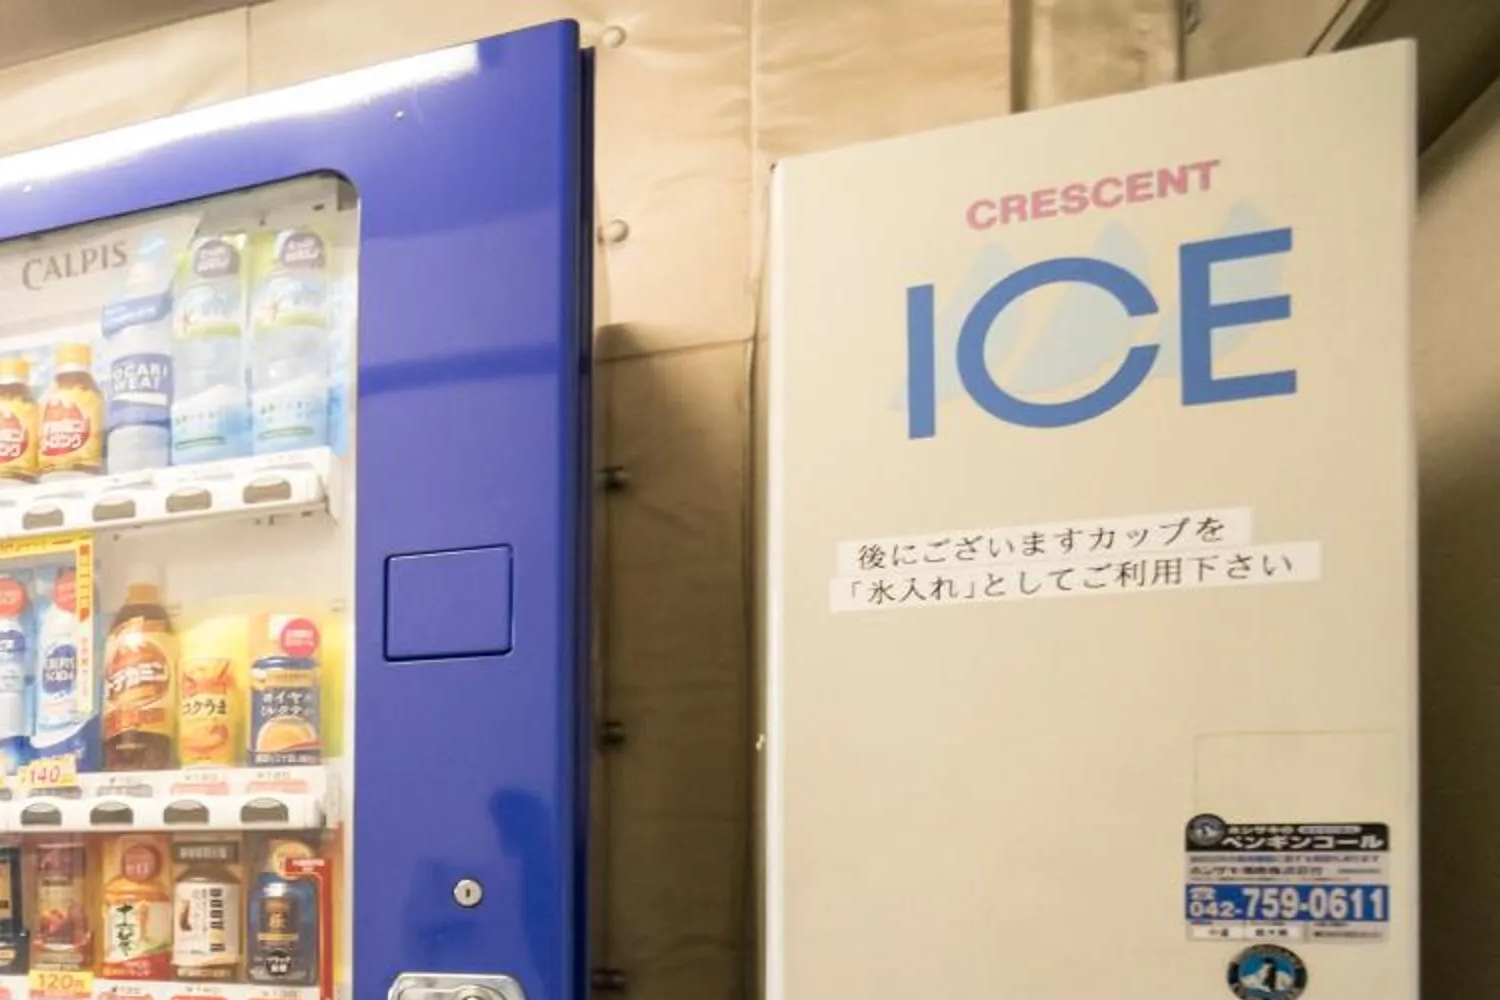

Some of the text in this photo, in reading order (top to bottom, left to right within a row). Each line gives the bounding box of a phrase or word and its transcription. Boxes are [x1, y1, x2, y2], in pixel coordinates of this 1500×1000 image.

[966, 159, 1222, 231] CRESCENT
[21, 240, 128, 291] CALPIS
[906, 226, 1297, 440] ICE
[858, 516, 1225, 571] 後にございますカップを
[1220, 834, 1384, 850] ペンギンコール
